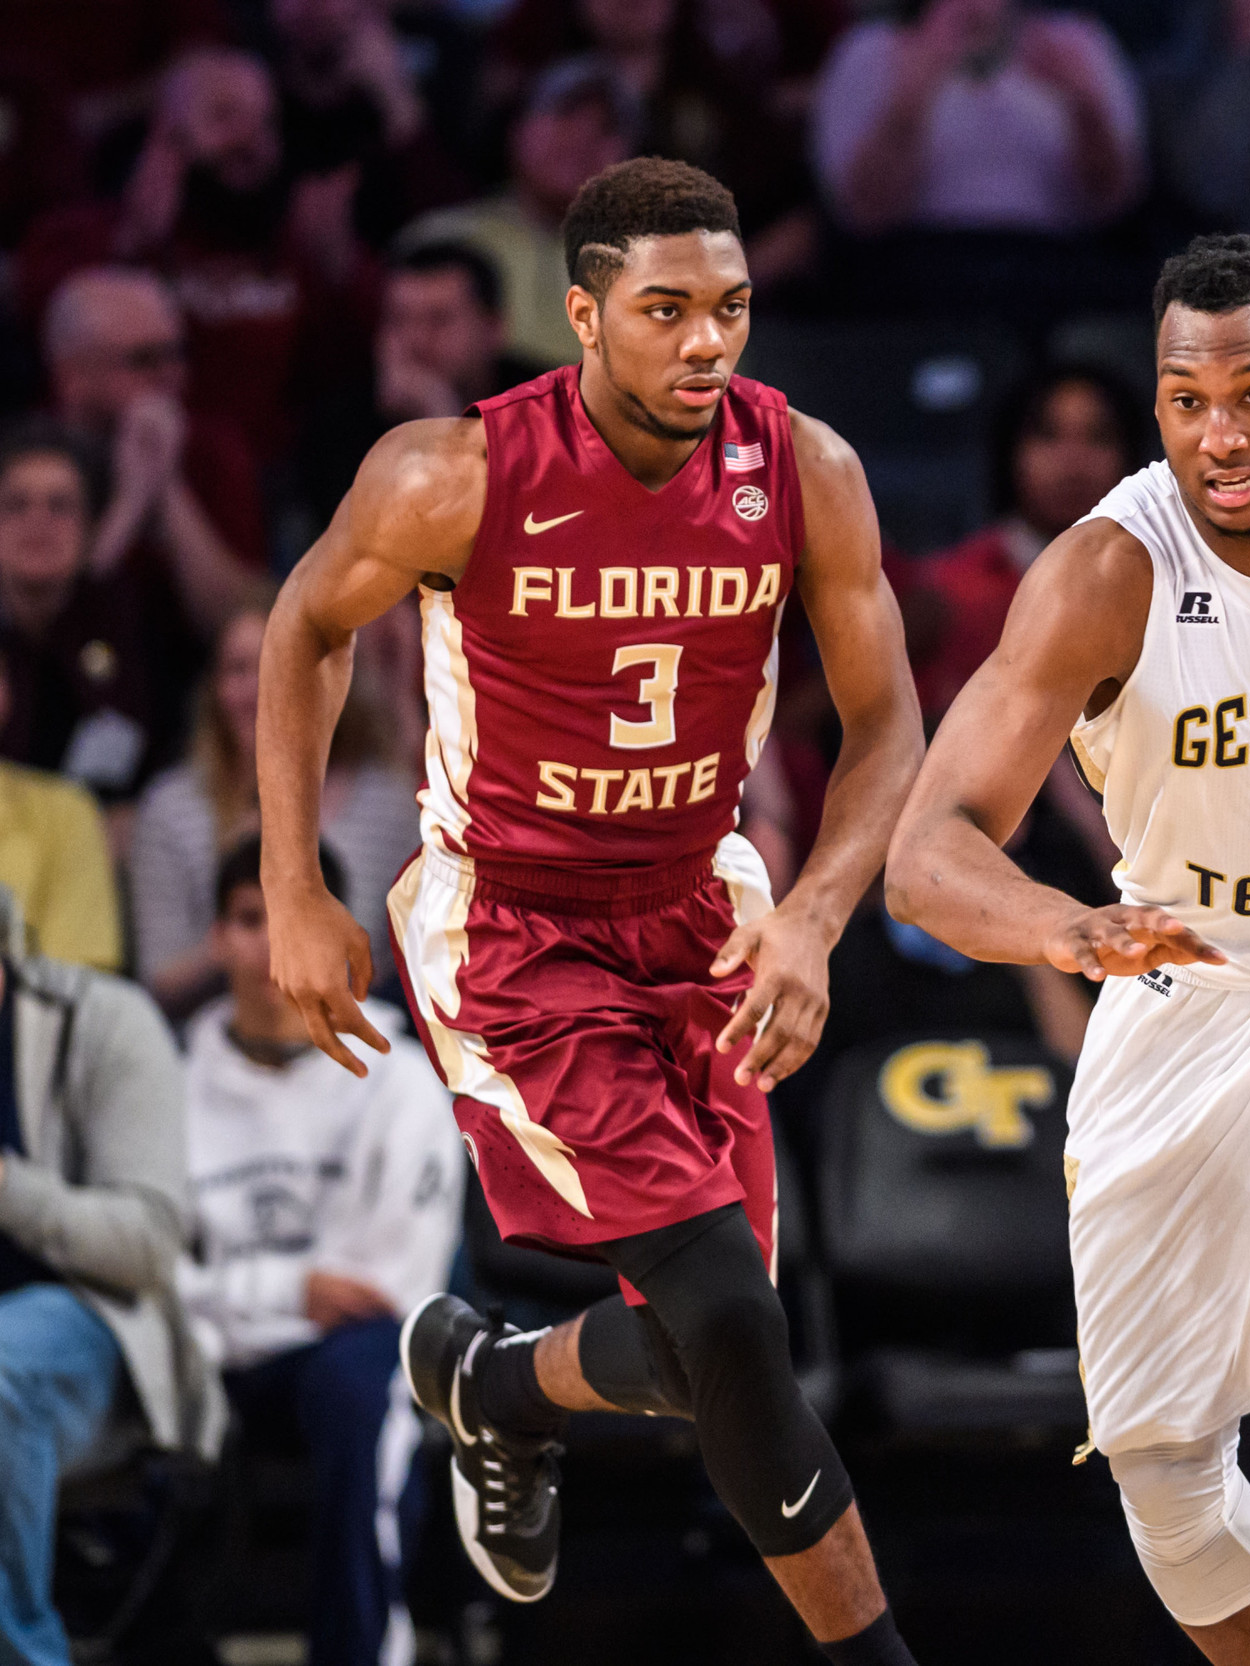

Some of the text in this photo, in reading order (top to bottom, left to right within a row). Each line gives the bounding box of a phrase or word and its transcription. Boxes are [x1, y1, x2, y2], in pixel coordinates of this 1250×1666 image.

[508, 563, 781, 619] FLORIDA
[609, 643, 684, 750] 3
[536, 752, 721, 815] STATE
